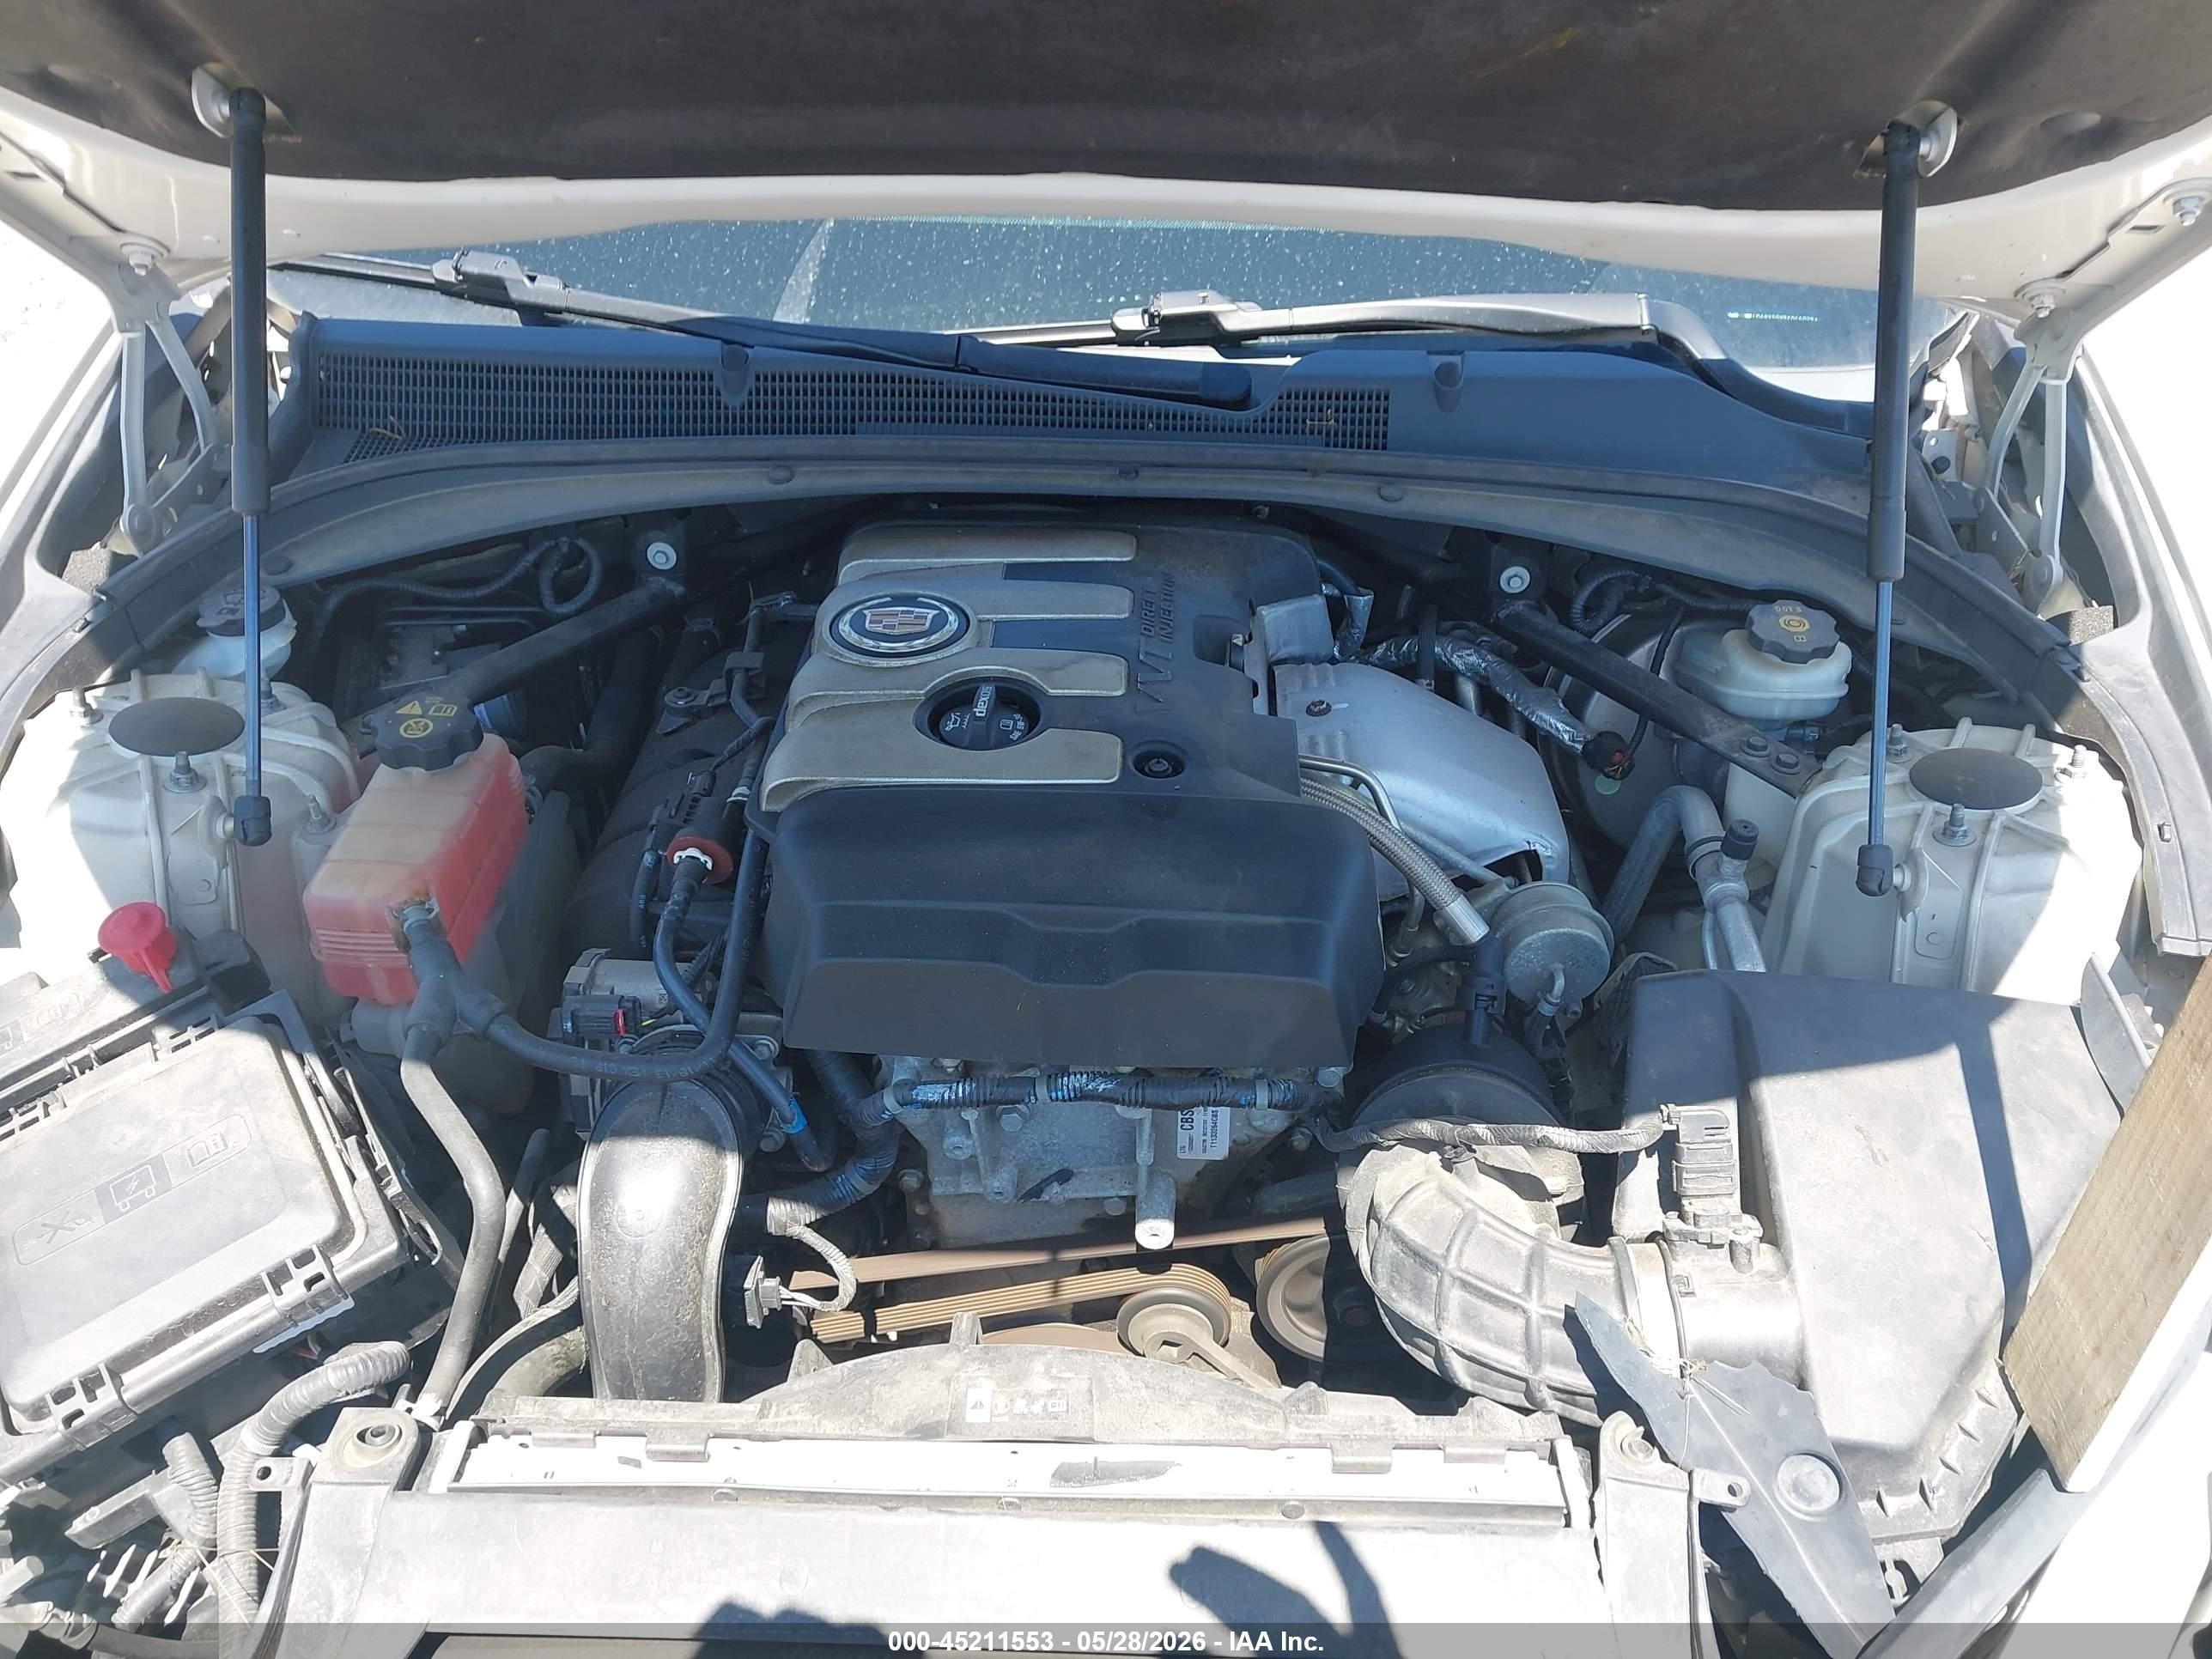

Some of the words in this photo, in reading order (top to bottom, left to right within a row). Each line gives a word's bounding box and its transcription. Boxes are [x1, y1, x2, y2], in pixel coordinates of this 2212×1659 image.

[1139, 586, 1157, 637] DIRECT
[1158, 572, 1175, 644] INJECTION
[1134, 636, 1173, 714] VVT
[973, 685, 993, 717] dexos
[1181, 1110, 1194, 1130] CBS
